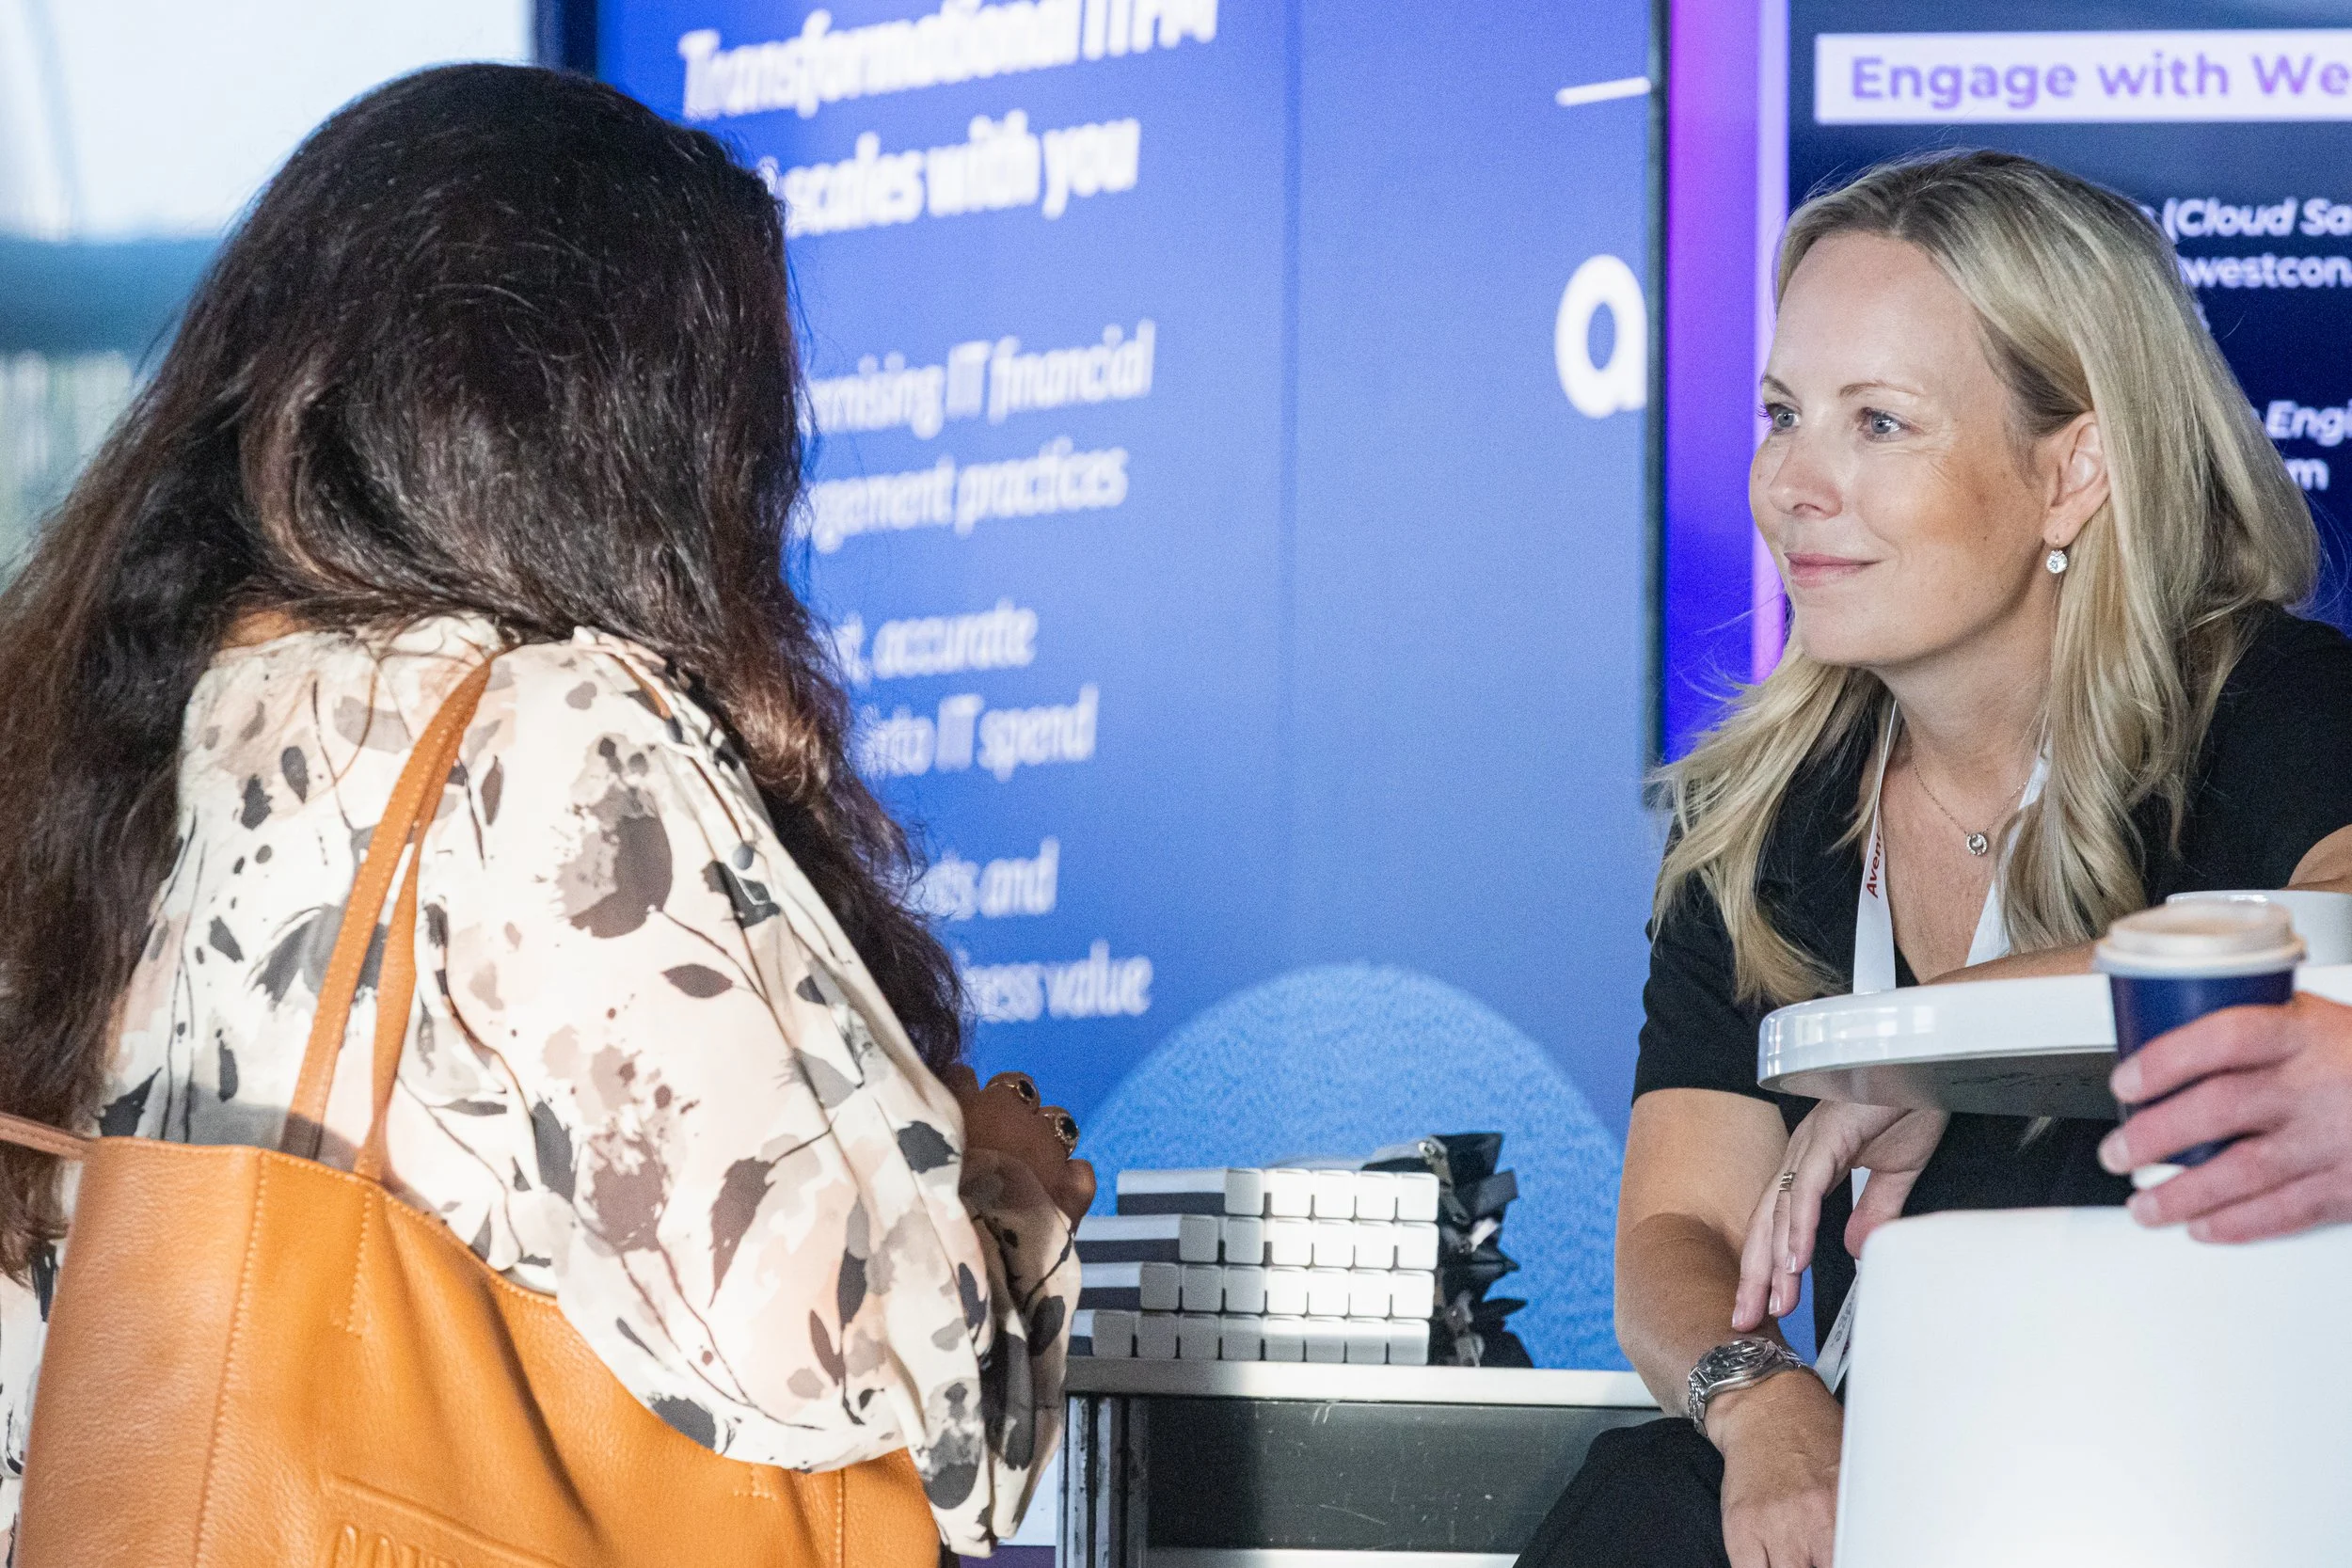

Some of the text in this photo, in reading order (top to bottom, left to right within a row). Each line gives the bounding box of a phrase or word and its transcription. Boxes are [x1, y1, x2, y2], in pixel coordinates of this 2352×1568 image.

[676, 0, 1081, 120] Transformational
[1851, 49, 2352, 111] Engage with We
[777, 109, 1141, 239] scales with you
[946, 340, 994, 420] IT
[987, 318, 1156, 423] financial
[954, 436, 1129, 536] practices
[872, 600, 1038, 679] accurate
[934, 692, 985, 773] IT
[976, 683, 1100, 783] spend
[978, 836, 1060, 918] and
[1043, 938, 1154, 1020] value
